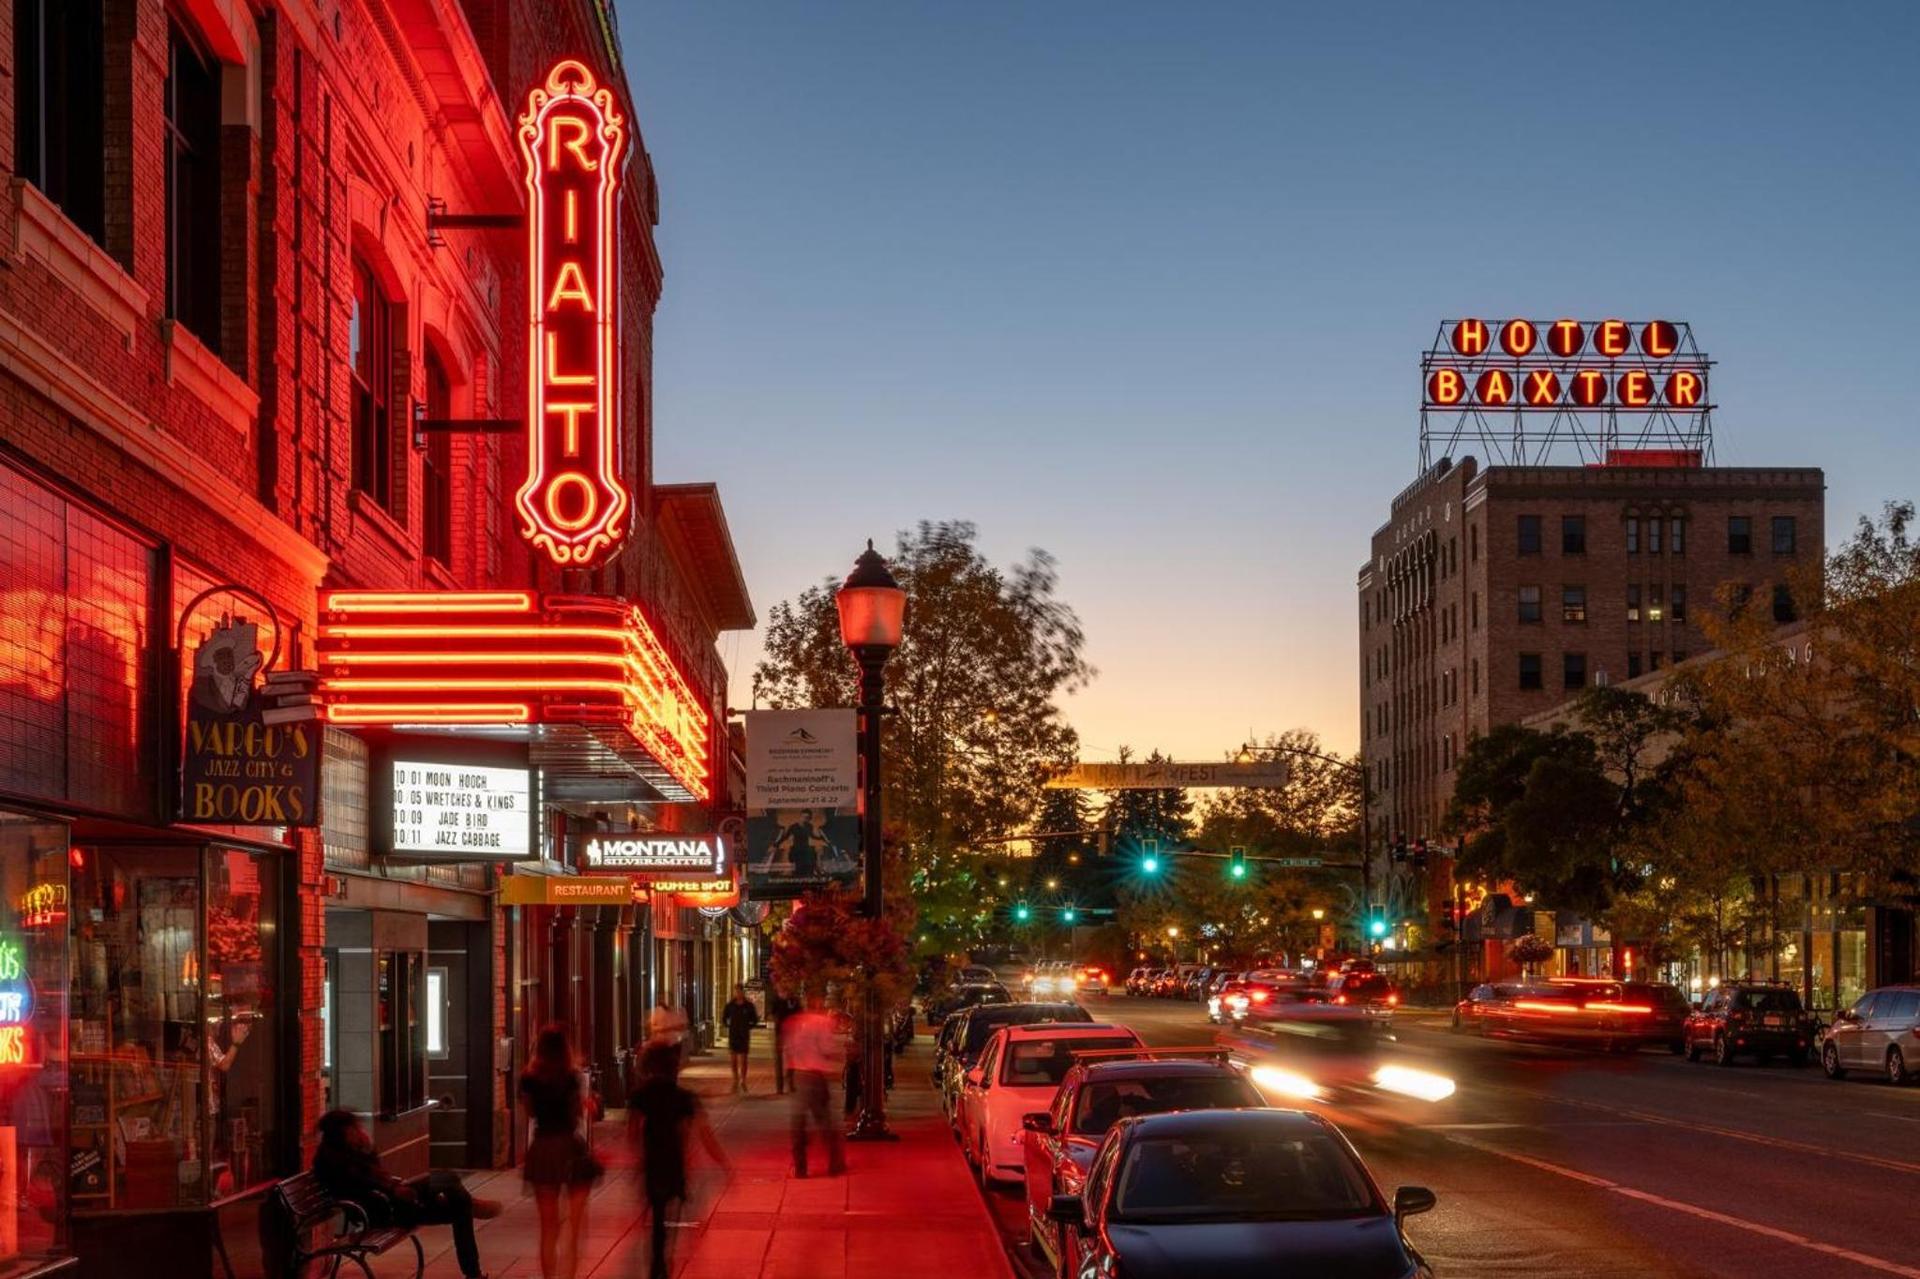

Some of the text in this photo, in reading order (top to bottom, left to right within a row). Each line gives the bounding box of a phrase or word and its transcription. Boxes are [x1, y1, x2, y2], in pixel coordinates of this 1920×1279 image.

[545, 116, 598, 530] RIALTO
[1462, 321, 1671, 354] HOTEL
[1438, 371, 1695, 404] BAXTER
[191, 720, 308, 758] VARGO'S
[205, 760, 240, 776] JAZZ
[245, 761, 277, 778] CITY
[426, 772, 451, 787] MOON
[459, 774, 487, 788] HOOCH
[195, 783, 303, 822] BOOKS
[426, 792, 471, 807] WRETCHES
[475, 795, 482, 808] &
[487, 795, 515, 809] KINGS
[438, 811, 459, 826] JADE
[466, 813, 488, 827] BIRD
[435, 831, 457, 845] JAZZ
[461, 832, 501, 847] CABBAGE
[603, 841, 712, 856] MONTANA
[555, 885, 625, 896] RESTAURANT
[701, 880, 731, 891] SPOT
